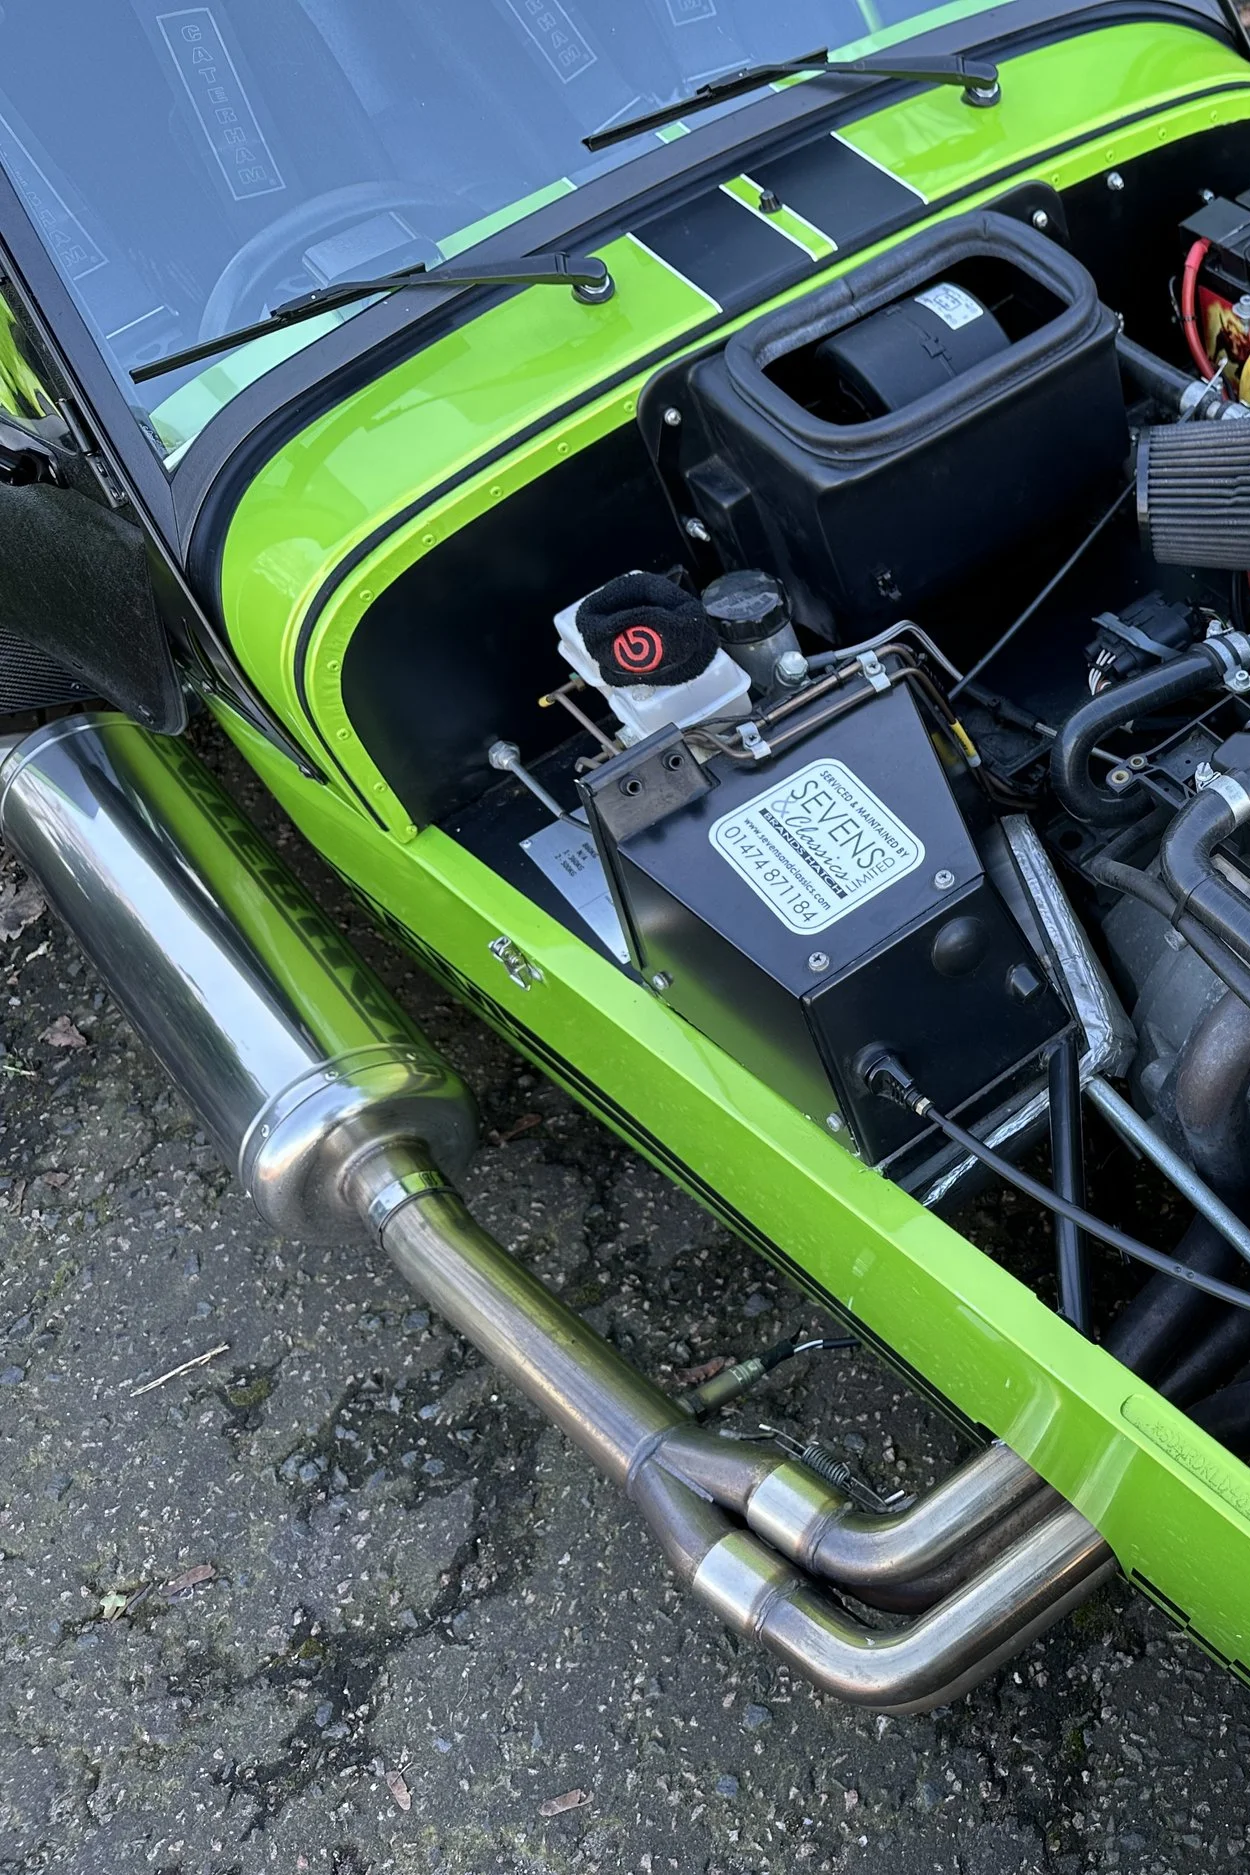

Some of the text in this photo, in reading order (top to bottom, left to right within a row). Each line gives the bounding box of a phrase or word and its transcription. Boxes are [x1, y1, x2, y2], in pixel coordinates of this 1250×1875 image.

[180, 24, 267, 185] CATERHAM
[762, 813, 844, 896] BRANDS HATCH
[771, 795, 850, 881] & Classics
[791, 780, 885, 869] SEVENS
[820, 771, 851, 803] SERVICED
[855, 807, 899, 850] MAINTAINED
[896, 846, 910, 858] BY
[724, 826, 818, 922] 01474 871184
[744, 818, 831, 911] www.sevensandclassics.com
[845, 857, 895, 893] LIMITED
